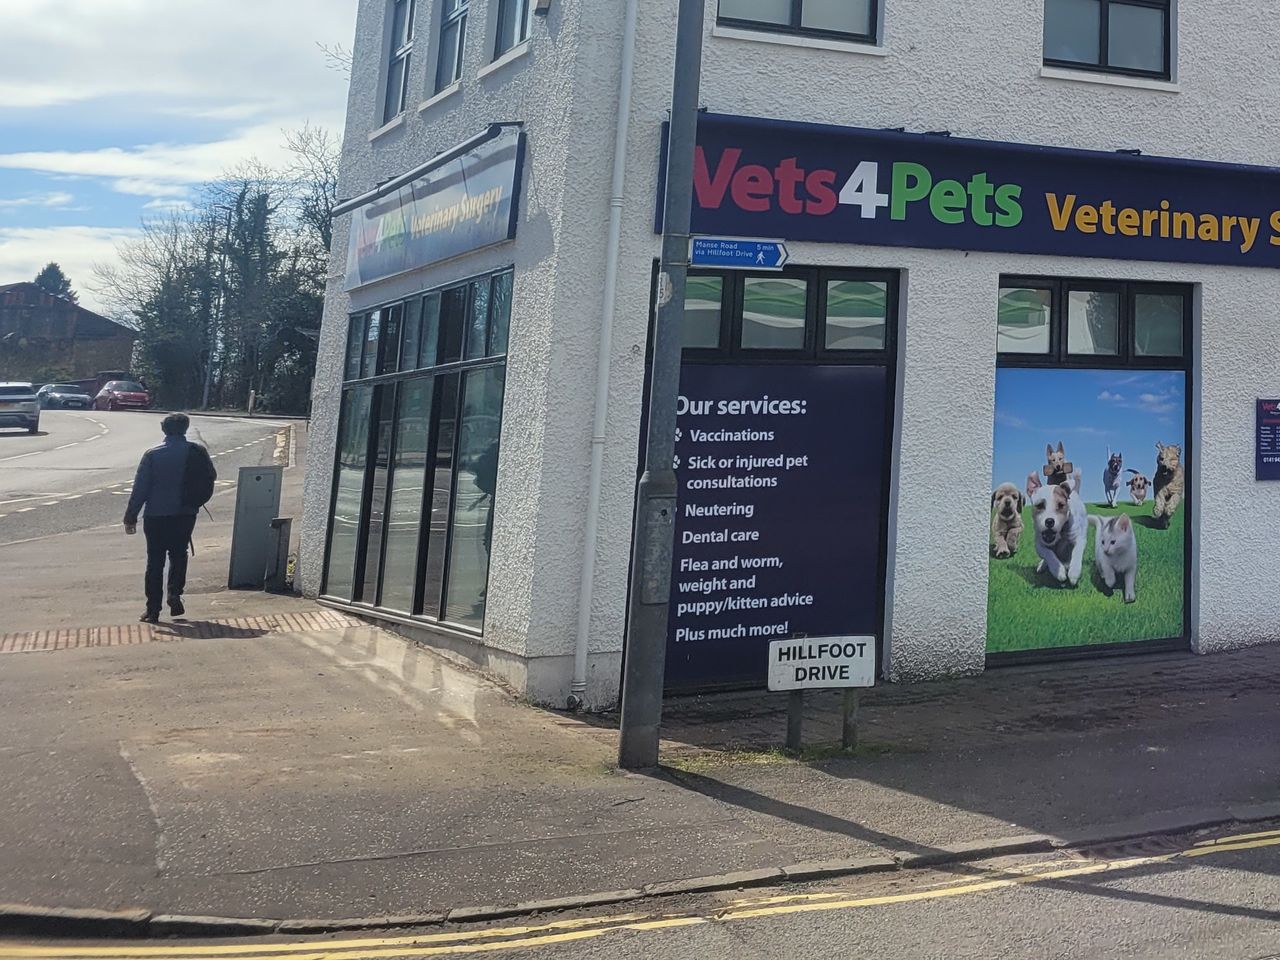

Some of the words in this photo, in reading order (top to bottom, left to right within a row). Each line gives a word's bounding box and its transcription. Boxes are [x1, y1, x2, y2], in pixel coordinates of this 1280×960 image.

[694, 145, 1023, 227] Vets4Pets
[411, 205, 459, 239] Veterinary
[460, 186, 503, 224] Surgery
[1047, 193, 1260, 253] Veterinary
[695, 241, 718, 249] Manse
[720, 242, 738, 250] Road
[707, 249, 733, 257] Hillfoot
[735, 250, 753, 258] Drive
[676, 395, 714, 416] Our
[717, 394, 807, 415] services:
[690, 428, 775, 442] Vaccinations
[688, 455, 716, 470] Sick
[718, 458, 734, 469] or
[735, 453, 784, 471] injured
[786, 455, 808, 470] pet
[686, 474, 778, 490] consultations
[685, 502, 754, 518] Neutering
[682, 528, 729, 544] Dental
[731, 530, 760, 542] care
[680, 557, 709, 572] Flea
[712, 555, 739, 570] and
[741, 556, 784, 570] worm,
[678, 576, 728, 595] weight
[729, 574, 756, 590] and
[677, 596, 768, 617] puppy/kitten
[770, 592, 814, 608] advice
[676, 627, 705, 642] Plus
[708, 623, 746, 640] much
[749, 621, 789, 637] more!
[778, 642, 867, 662] HILLFOOT
[795, 665, 850, 682] DRIVE
